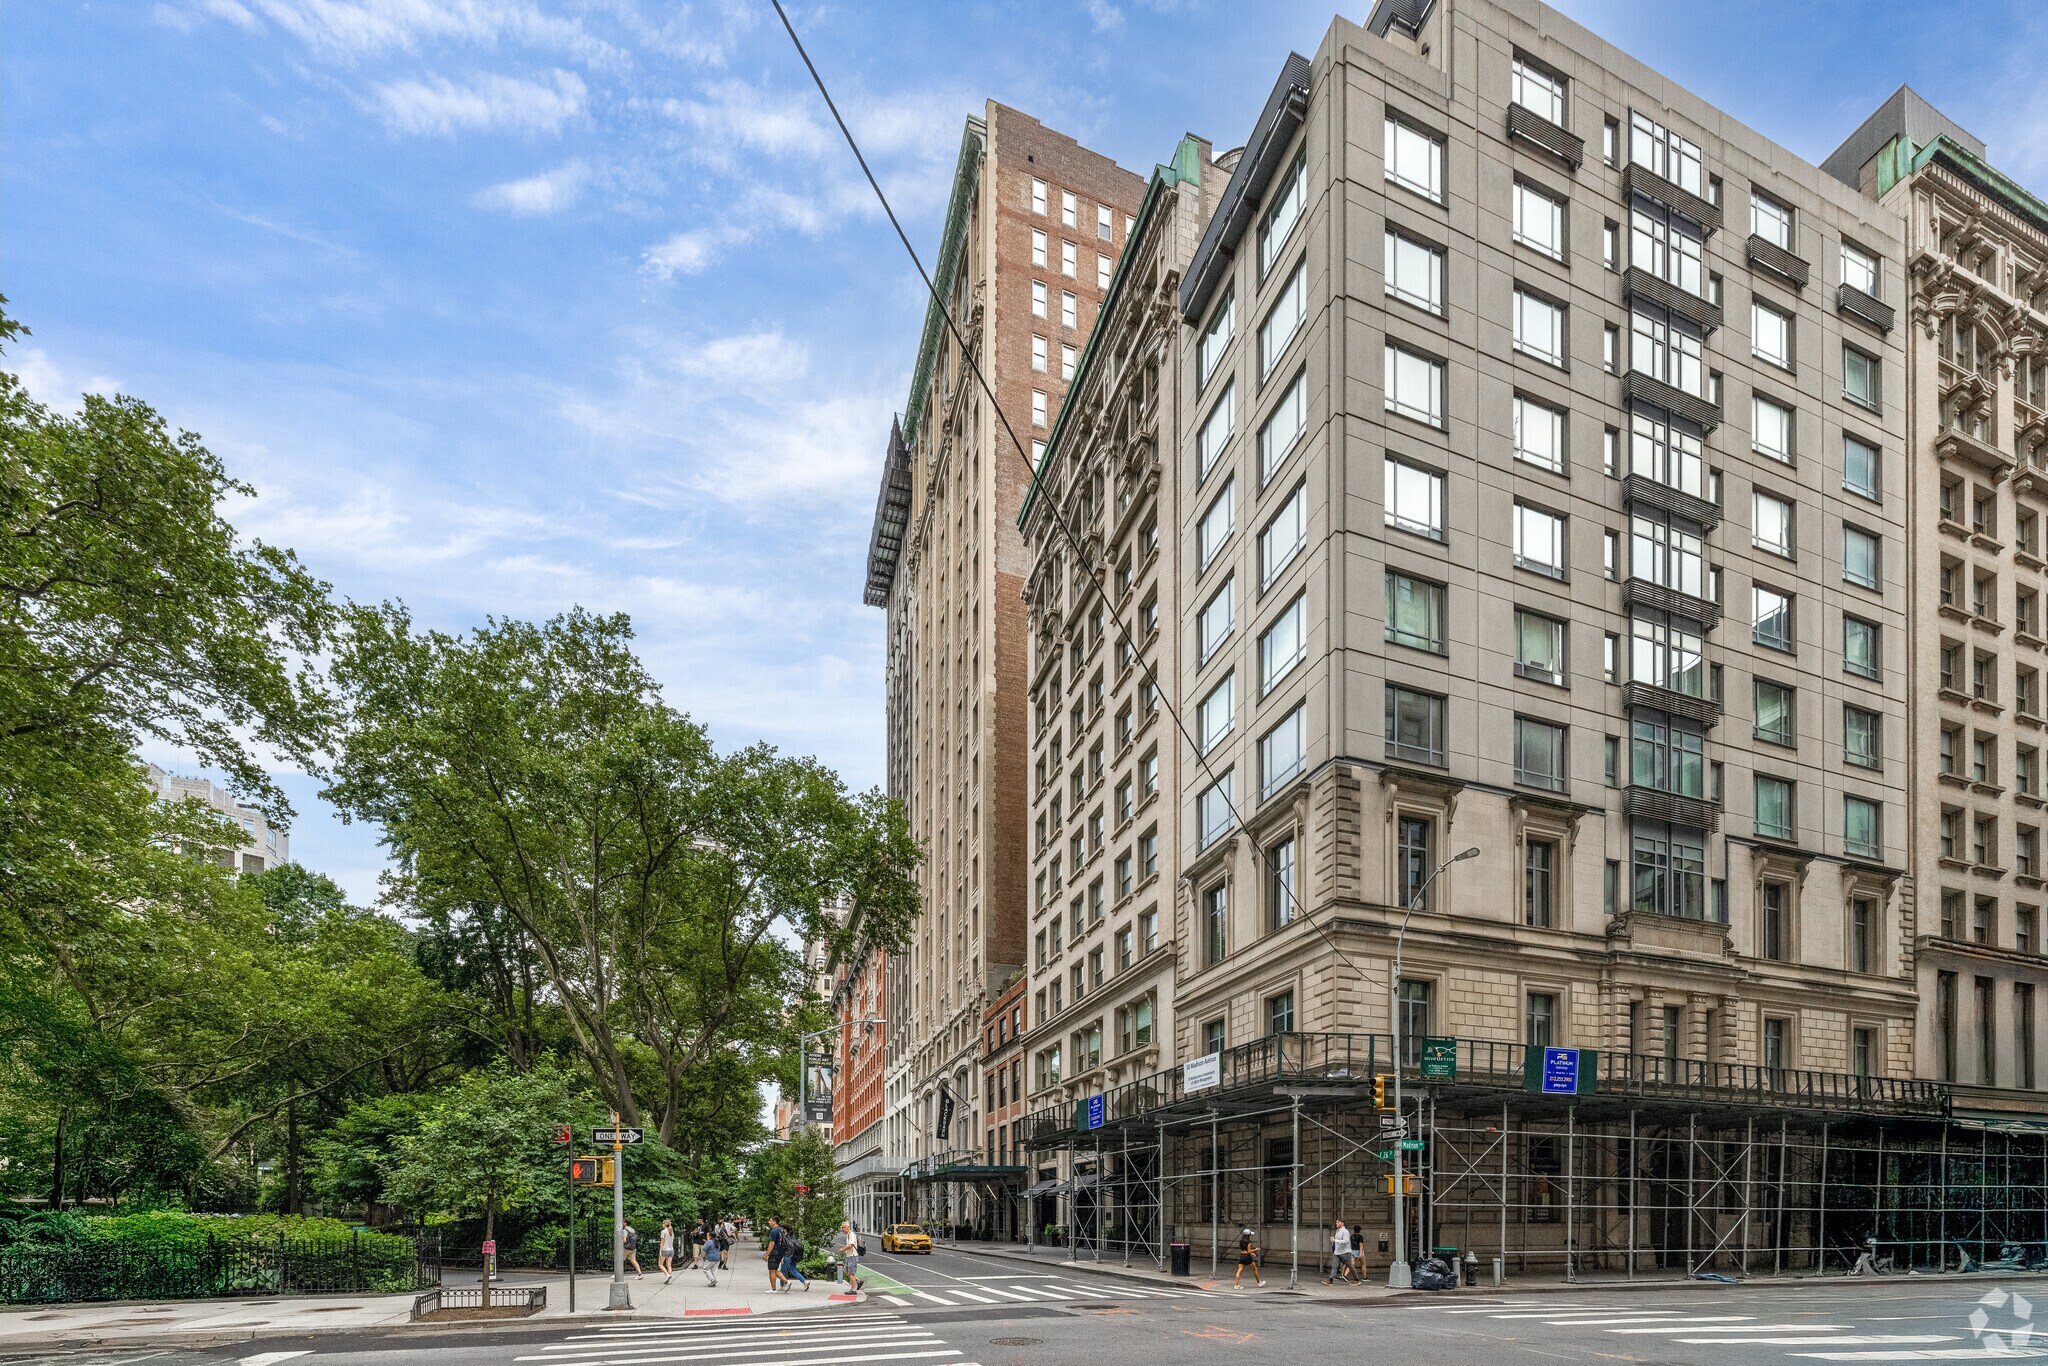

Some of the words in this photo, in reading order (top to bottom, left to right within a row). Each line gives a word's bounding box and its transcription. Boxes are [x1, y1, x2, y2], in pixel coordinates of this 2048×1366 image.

[1191, 1061, 1203, 1069] Madison
[941, 1099, 949, 1137] BLACKBARN
[1383, 1151, 1389, 1159] 26
